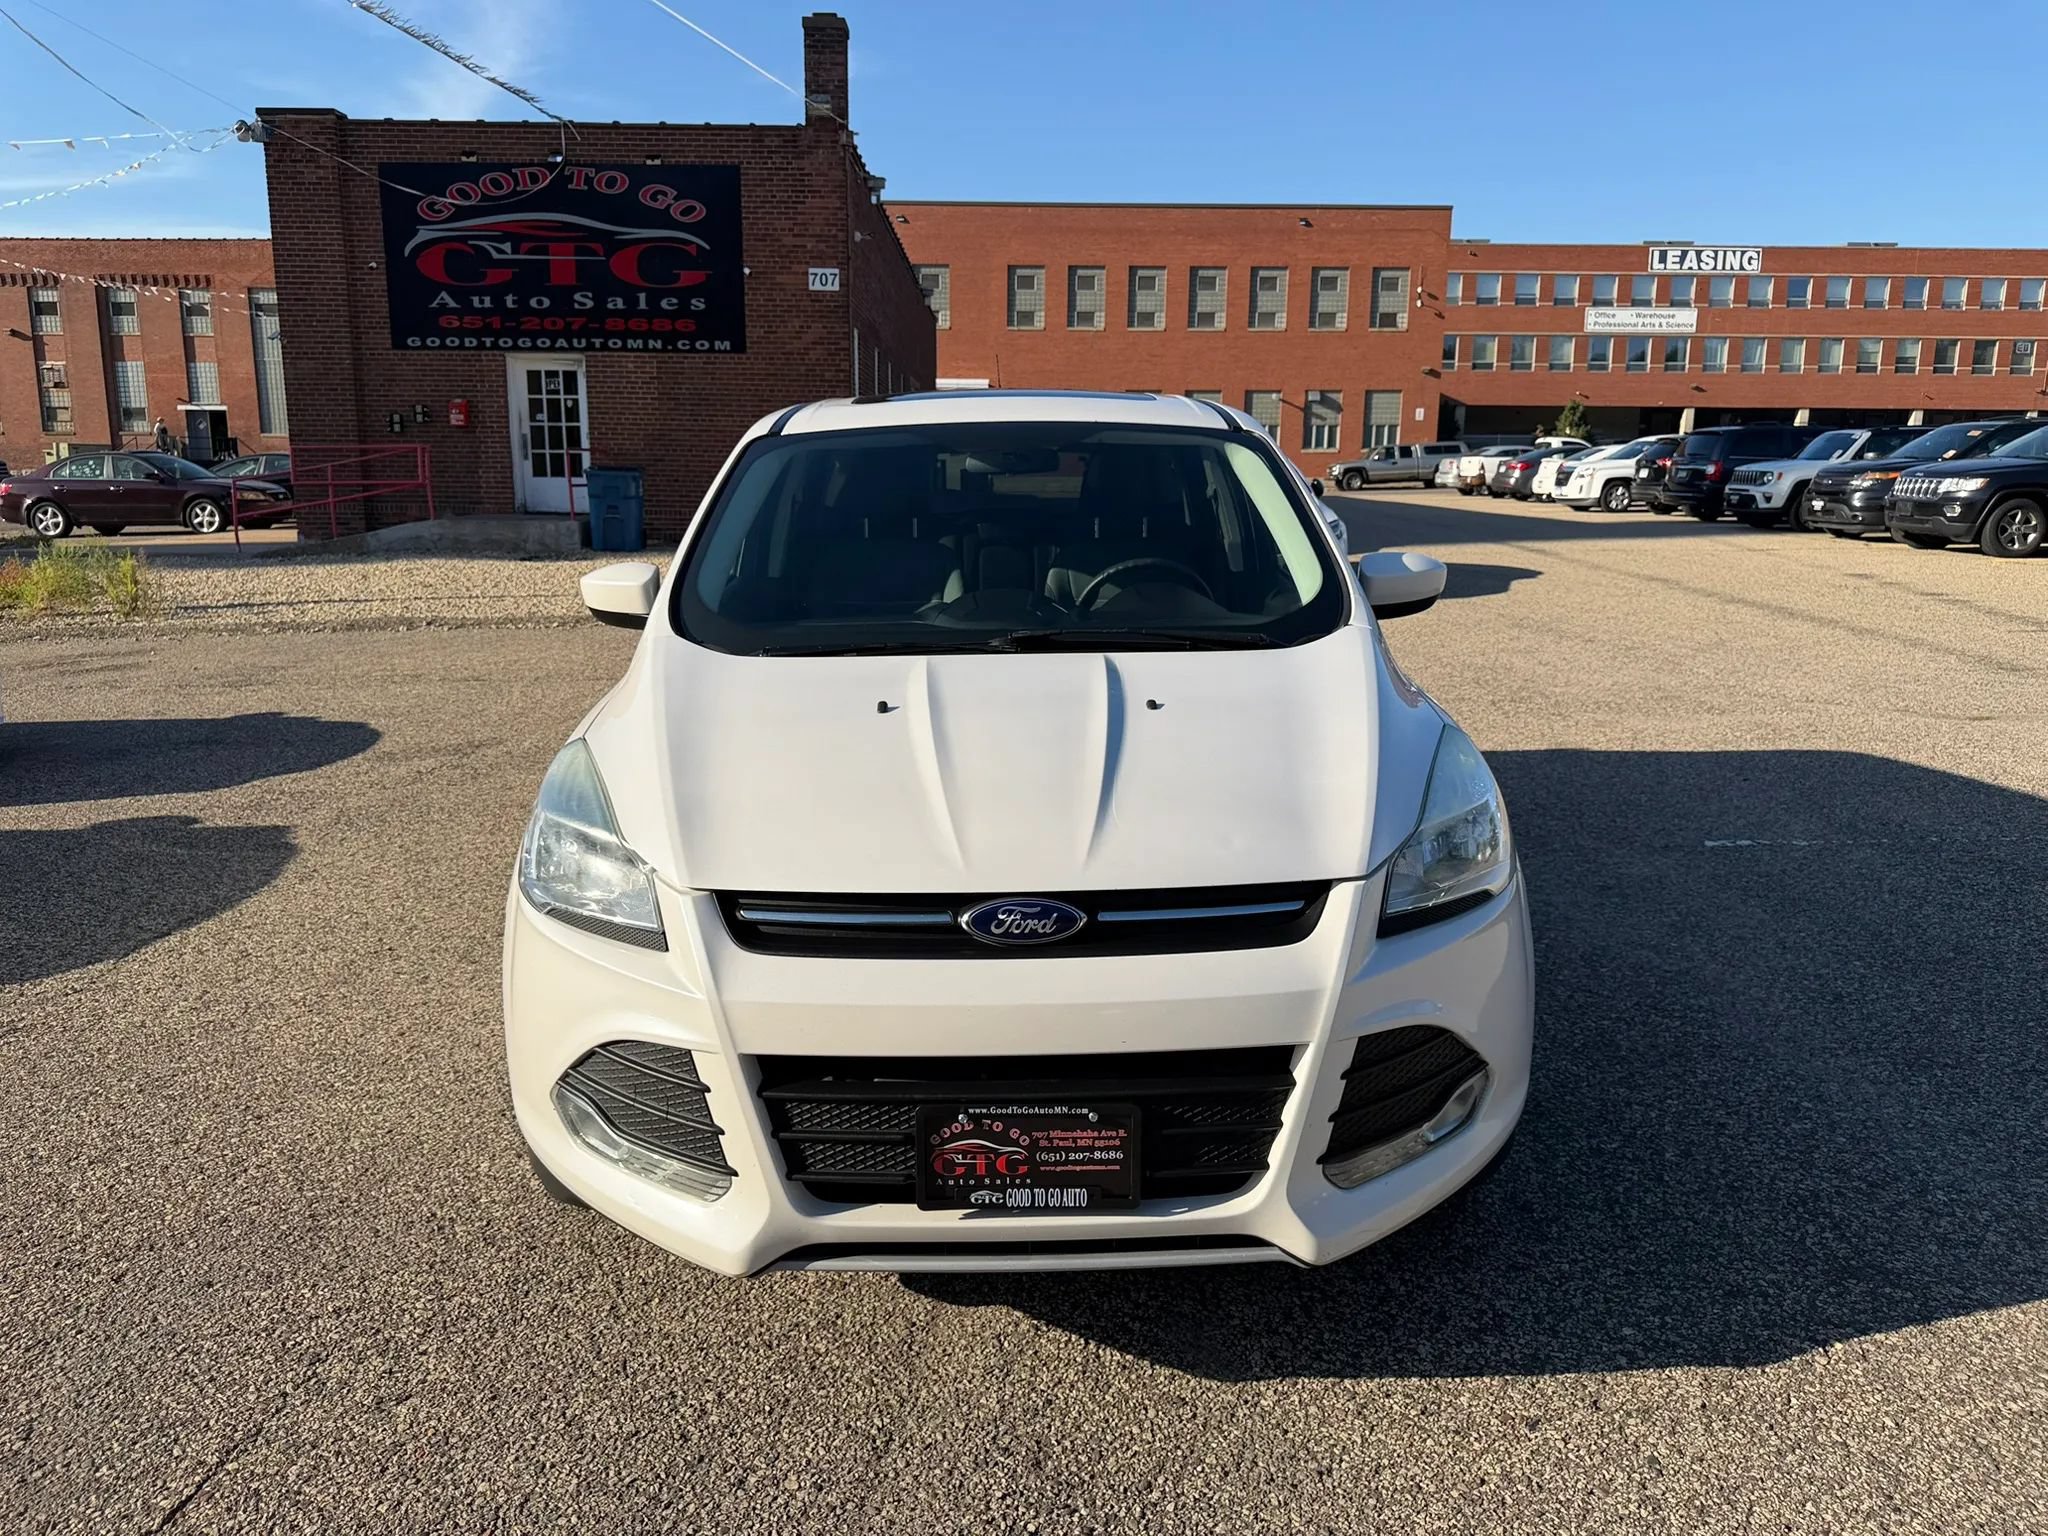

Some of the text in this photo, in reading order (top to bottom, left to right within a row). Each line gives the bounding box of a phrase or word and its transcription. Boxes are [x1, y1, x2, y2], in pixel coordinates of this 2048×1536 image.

[417, 166, 707, 223] GOOD TO GO
[1652, 250, 1759, 271] LEASING
[809, 272, 838, 287] 707
[428, 290, 706, 311] Auto Sales
[438, 315, 697, 332] 651-207-8686
[1593, 321, 1694, 329] Professional Arts & Science
[406, 336, 732, 351] GOODTOGOAUTOMN.COM
[990, 906, 1058, 934] Ford
[968, 1106, 1089, 1115] www.GoodToGoAutoMN.com
[929, 1119, 1030, 1146] GOOD TO GO
[1032, 1131, 1048, 1139] 707
[1077, 1138, 1093, 1147] MN
[1036, 1150, 1124, 1162] (651) 207-8686
[936, 1176, 1031, 1185] Auto Sales
[1006, 1188, 1032, 1208] GOOD
[1034, 1188, 1046, 1208] TO
[1048, 1188, 1062, 1208] GO
[1062, 1188, 1088, 1208] AUTO
